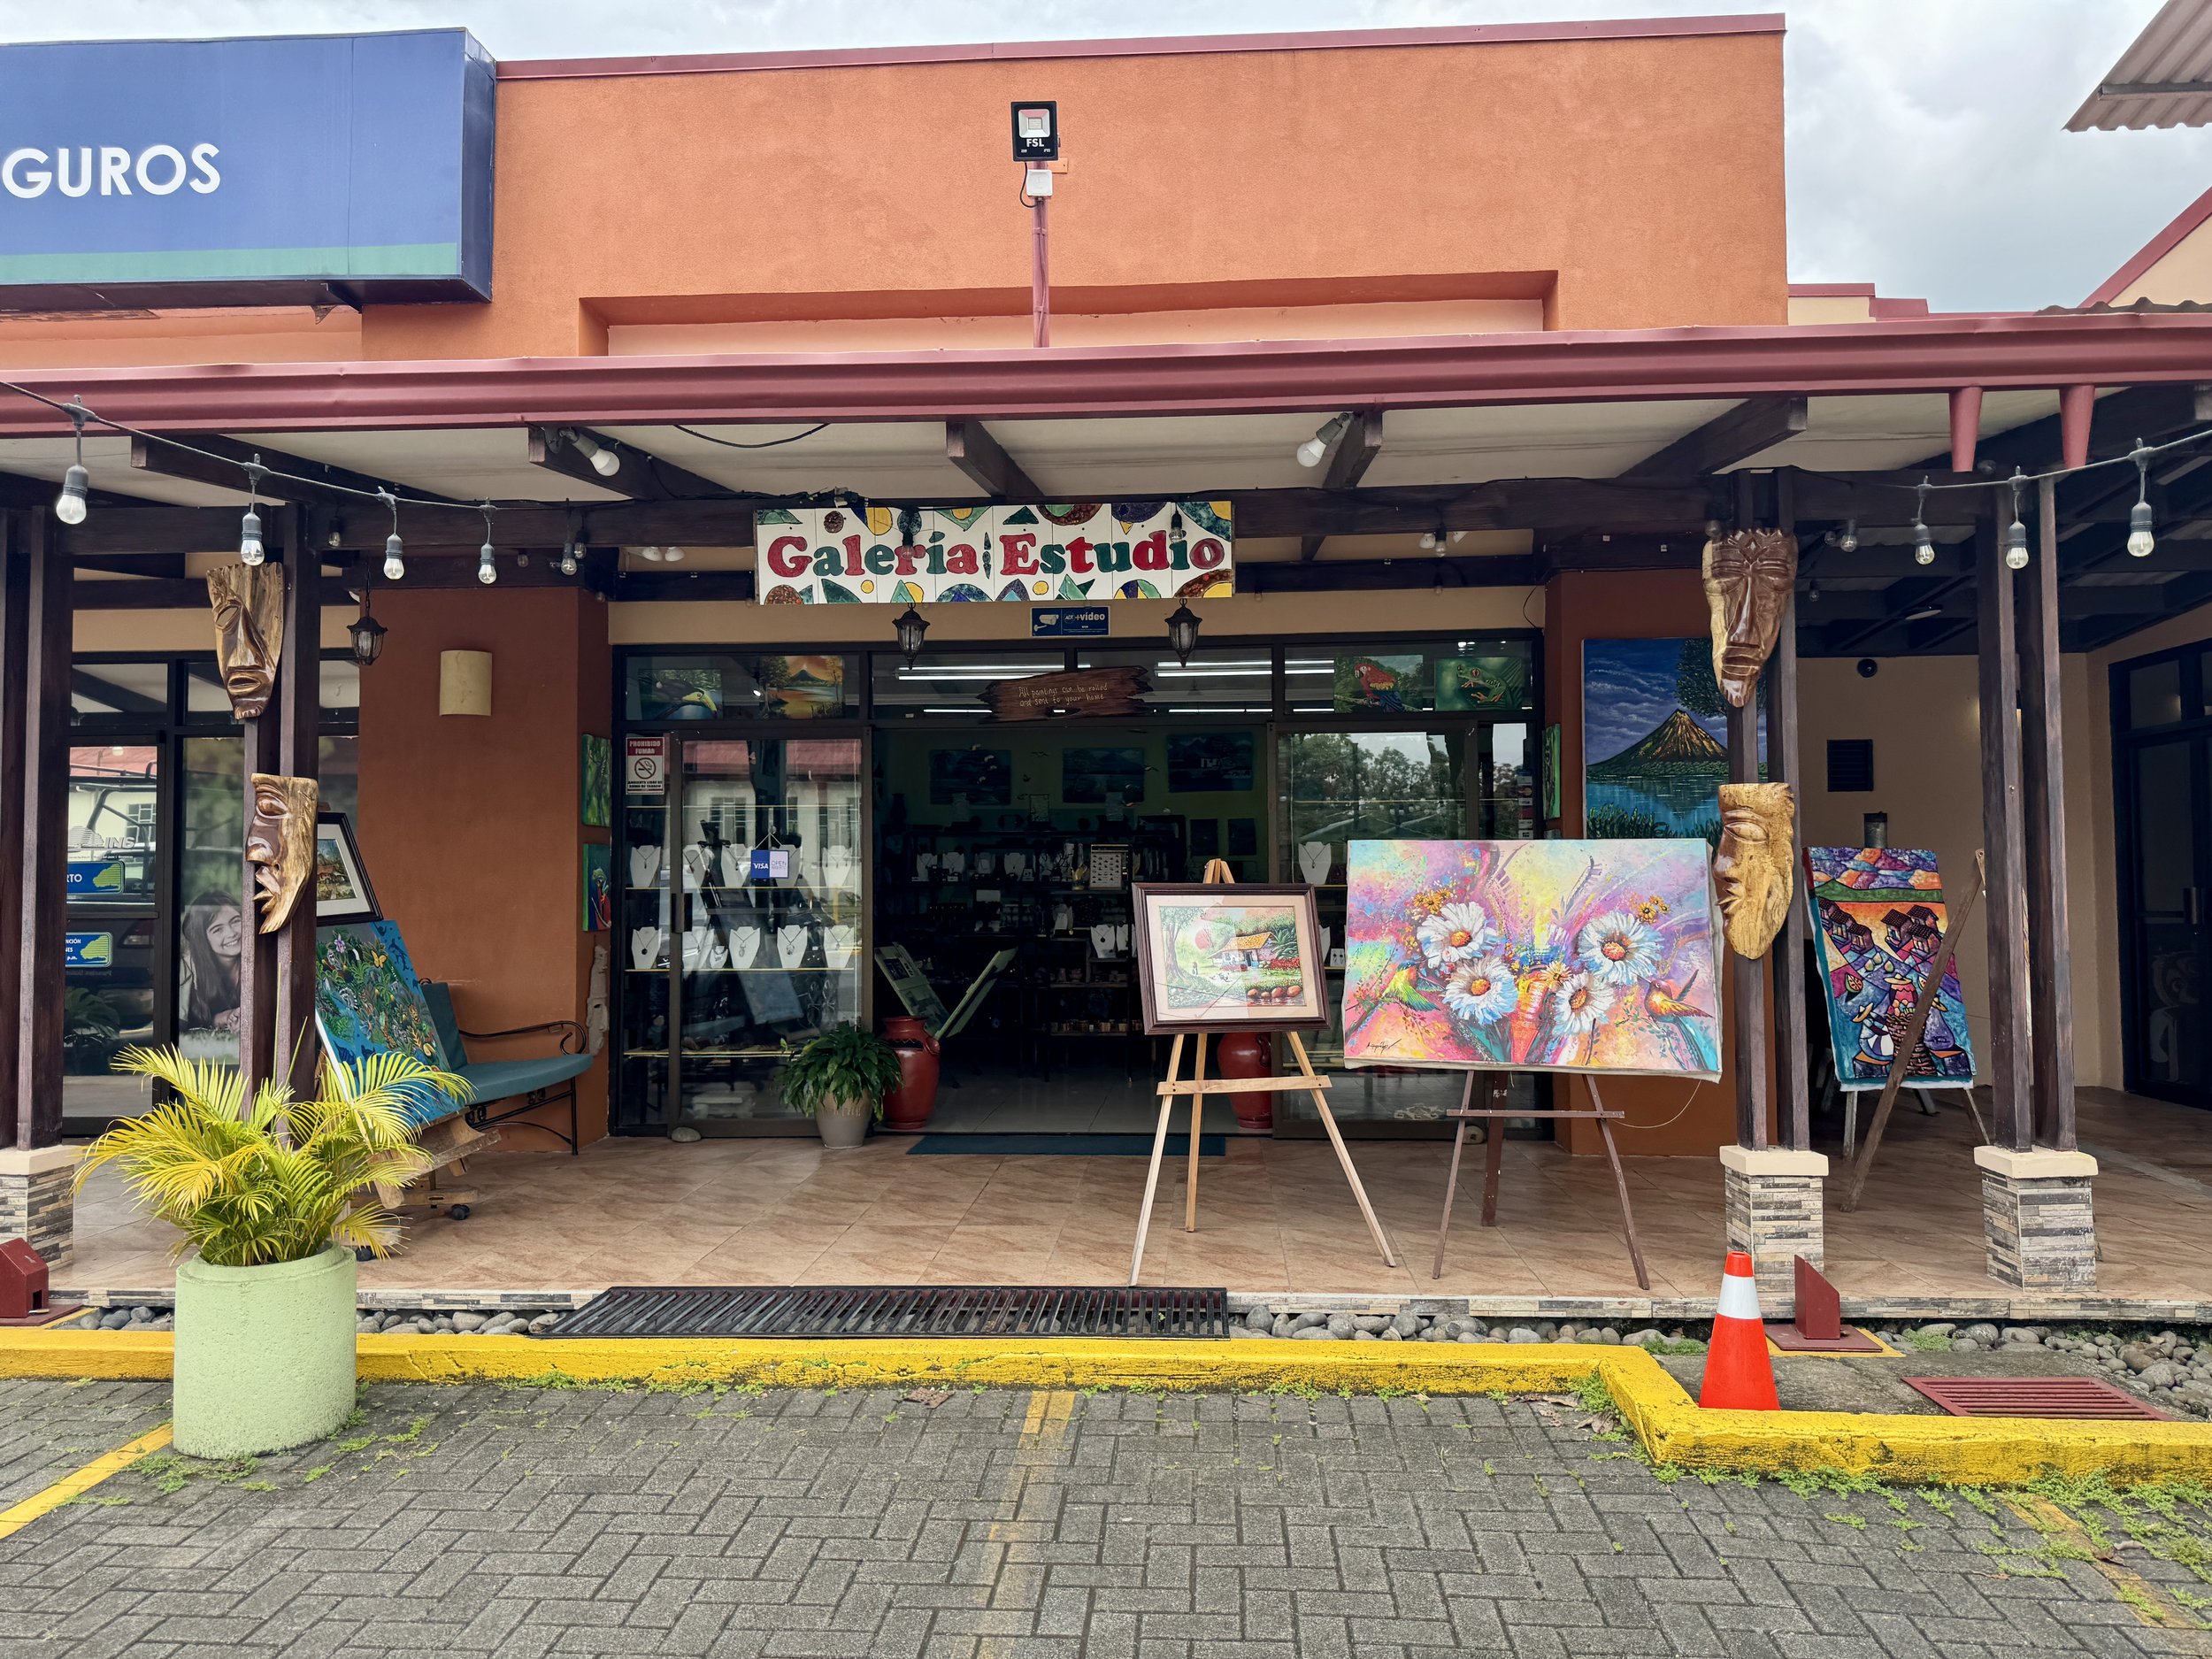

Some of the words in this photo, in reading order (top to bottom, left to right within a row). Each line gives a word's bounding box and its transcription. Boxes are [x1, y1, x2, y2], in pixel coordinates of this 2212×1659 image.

[1026, 138, 1044, 147] FSL
[2, 143, 221, 199] GUROS
[767, 531, 979, 578] Galería
[999, 530, 1225, 576] Estudio
[1018, 687, 1029, 697] All
[1088, 682, 1108, 691] rolled
[1065, 696, 1080, 705] your
